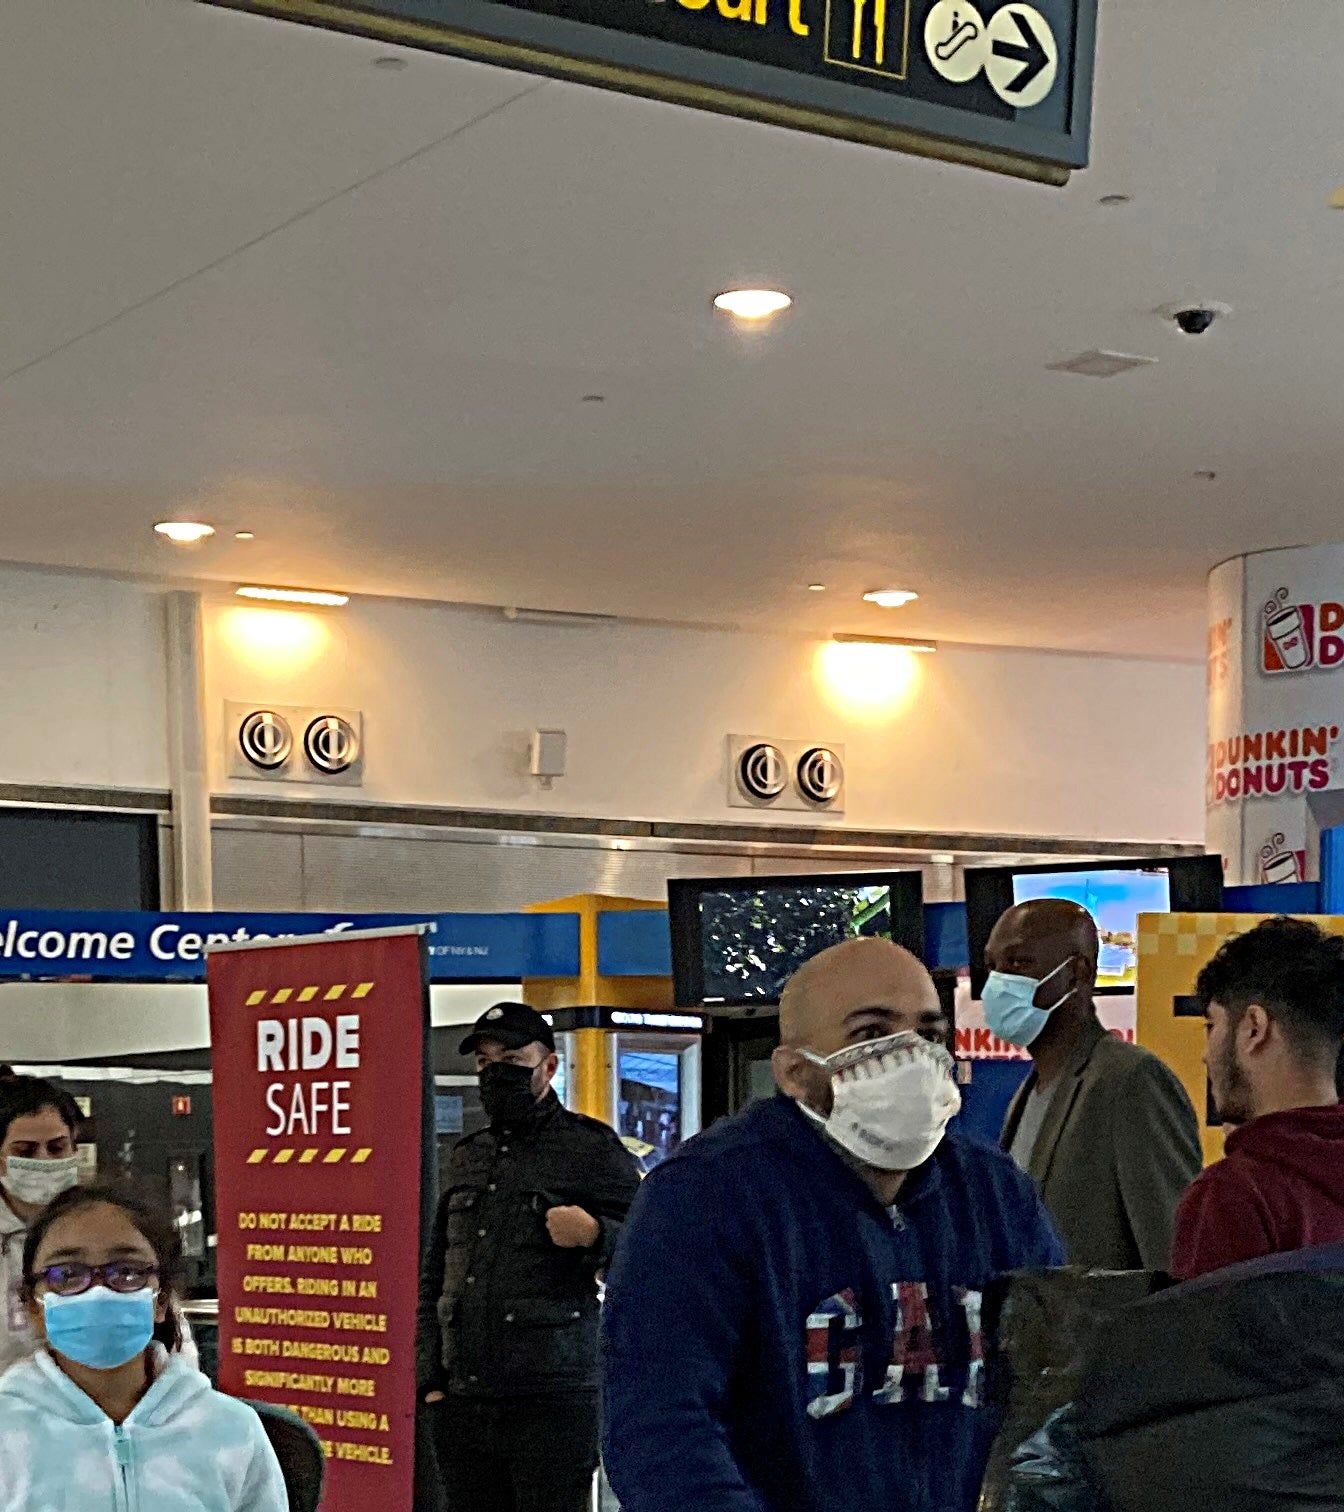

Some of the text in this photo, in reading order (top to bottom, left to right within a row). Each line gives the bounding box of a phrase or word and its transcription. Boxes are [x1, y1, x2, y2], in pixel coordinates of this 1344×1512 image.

[1213, 725, 1339, 768] DUNKIN'
[1214, 758, 1330, 799] DONUTS
[257, 1014, 360, 1072] RIDE
[266, 1081, 351, 1136] SAFE
[239, 1213, 382, 1232] DO NOT ACCEPT A RIDE
[247, 1244, 372, 1265] FROM ANYONE WHO
[243, 1275, 377, 1298] OFFERS. RIDING IN AN
[235, 1306, 387, 1332] UNAUTHORIZED VEHICLE
[231, 1338, 390, 1365] IS BOTH DANGEROUS AND
[244, 1370, 375, 1397] SIGNIFICANTLY MORE
[301, 1406, 334, 1425] THAN
[337, 1409, 377, 1429] USING
[379, 1414, 390, 1432] A
[336, 1442, 393, 1465] VEHICLE.
